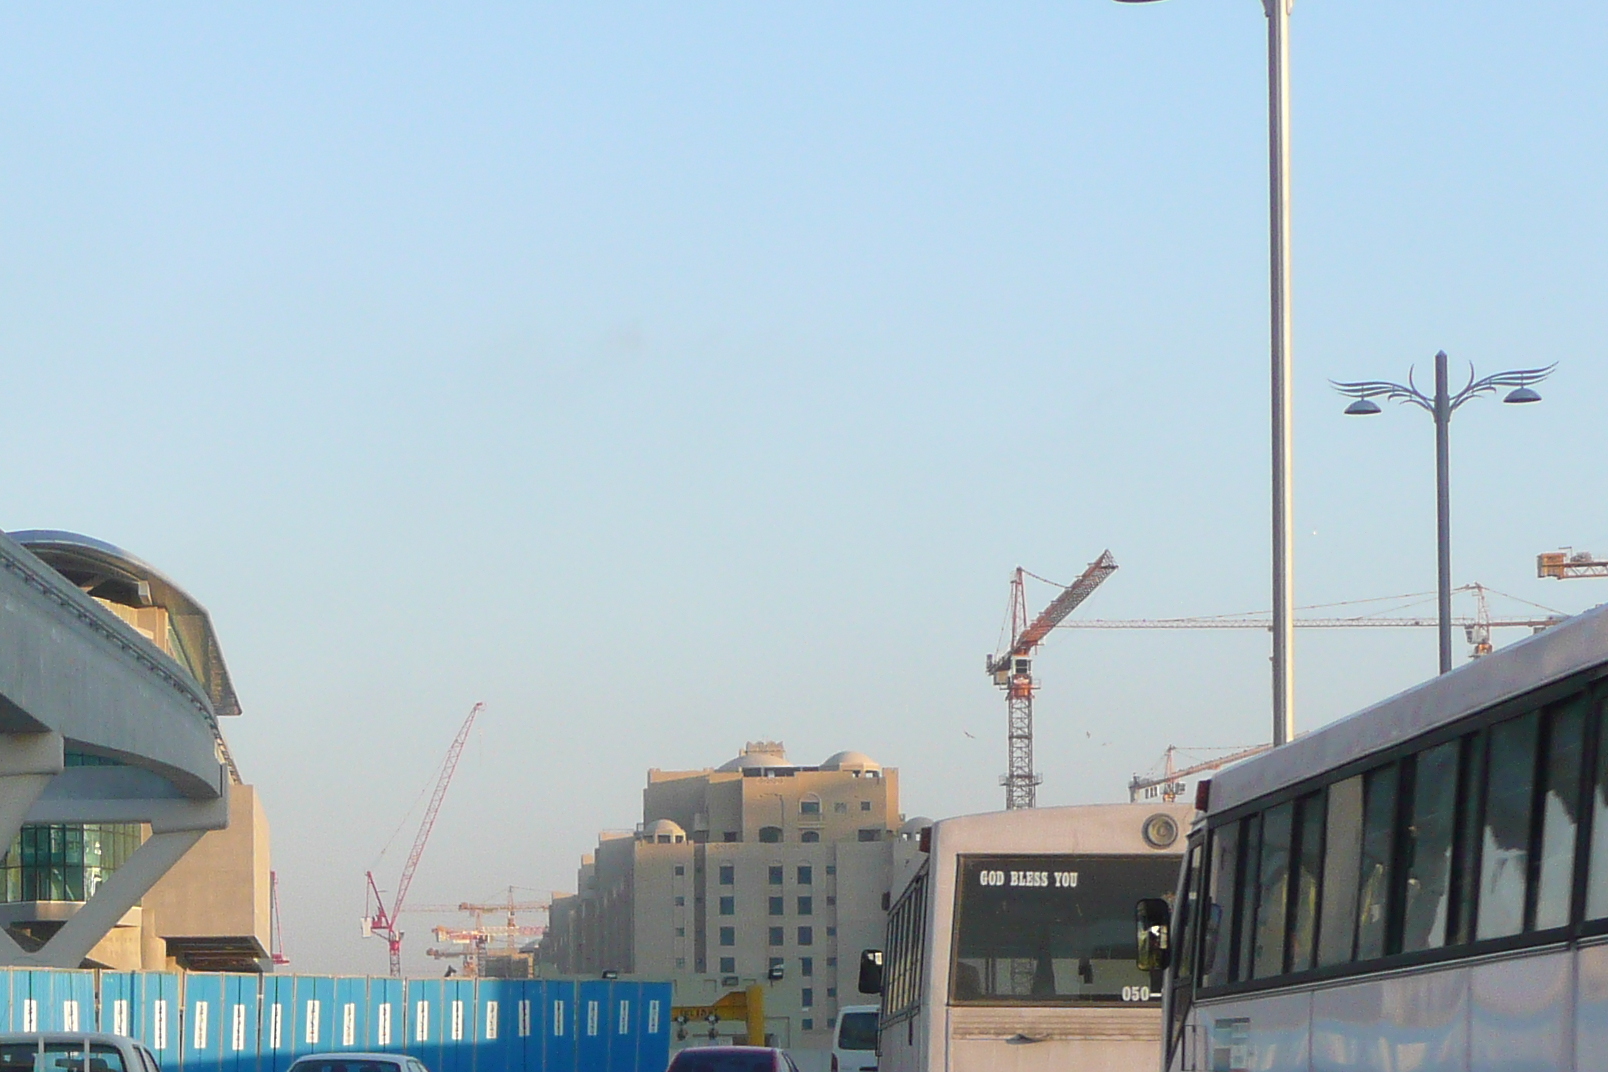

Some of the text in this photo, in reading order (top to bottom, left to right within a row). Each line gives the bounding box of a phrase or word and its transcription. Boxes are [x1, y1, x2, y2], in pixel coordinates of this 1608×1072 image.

[979, 870, 1079, 887] GOD BLESS YOU
